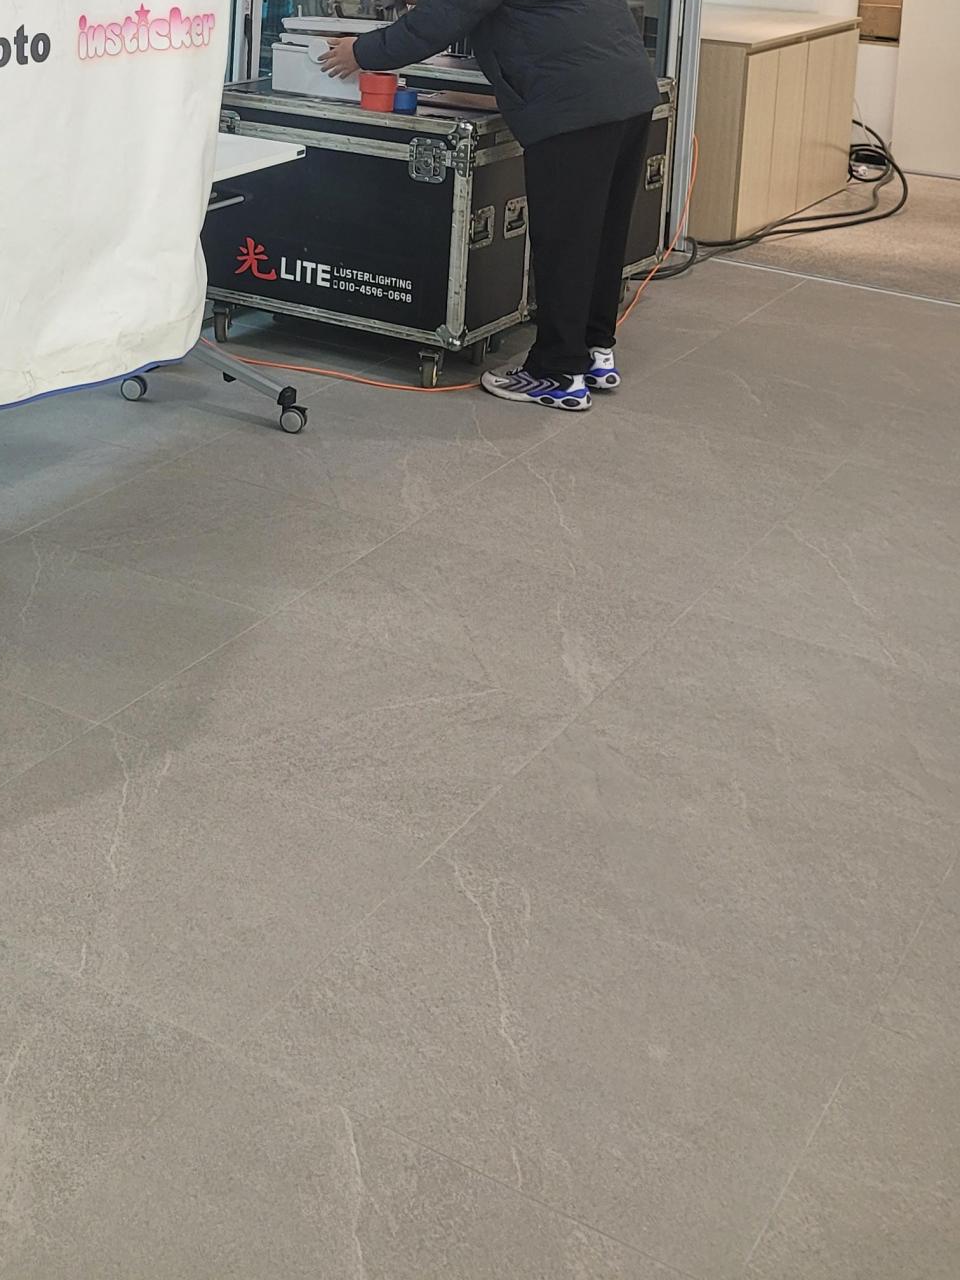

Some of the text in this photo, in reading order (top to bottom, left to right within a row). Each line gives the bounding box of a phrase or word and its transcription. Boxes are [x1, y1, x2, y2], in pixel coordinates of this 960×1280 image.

[77, 3, 215, 60] insticker
[235, 237, 331, 288] 光 LITE
[334, 266, 412, 290] LUSTERLIGHTING
[339, 280, 412, 303] 010-4596-0698
